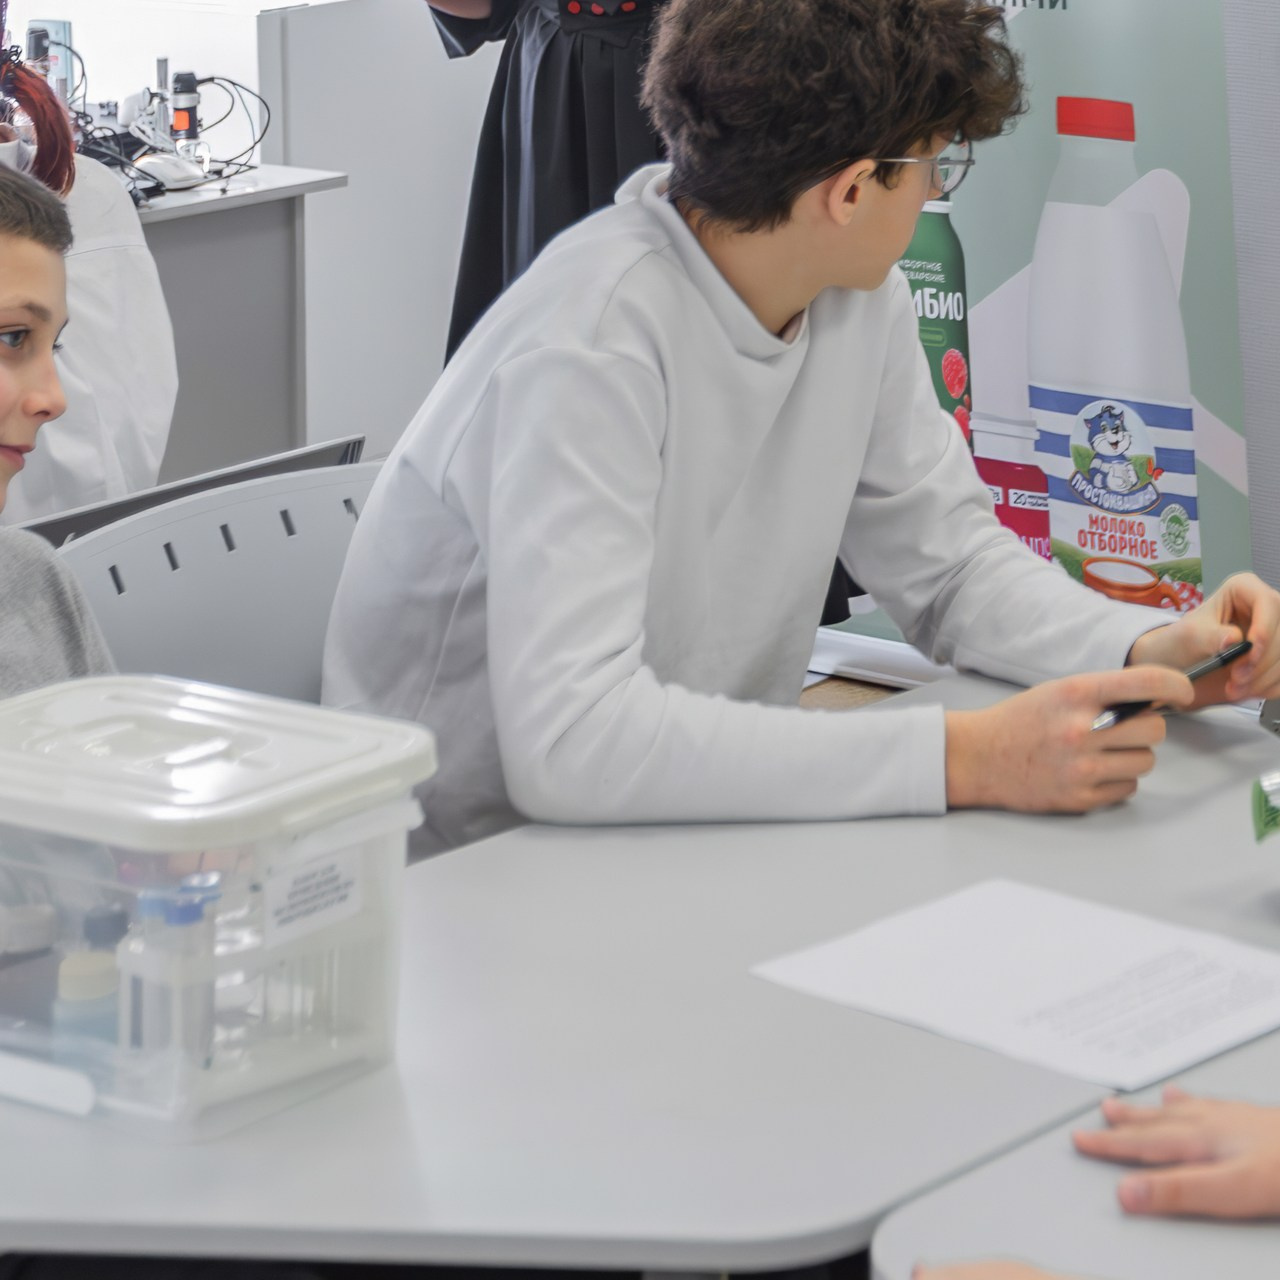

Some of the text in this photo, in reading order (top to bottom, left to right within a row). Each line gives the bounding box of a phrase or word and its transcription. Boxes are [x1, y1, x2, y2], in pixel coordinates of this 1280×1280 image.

[913, 287, 964, 321] ИБИО
[1088, 513, 1146, 538] МОЛОКО
[1077, 529, 1159, 560] ОТБОРНОЕ
